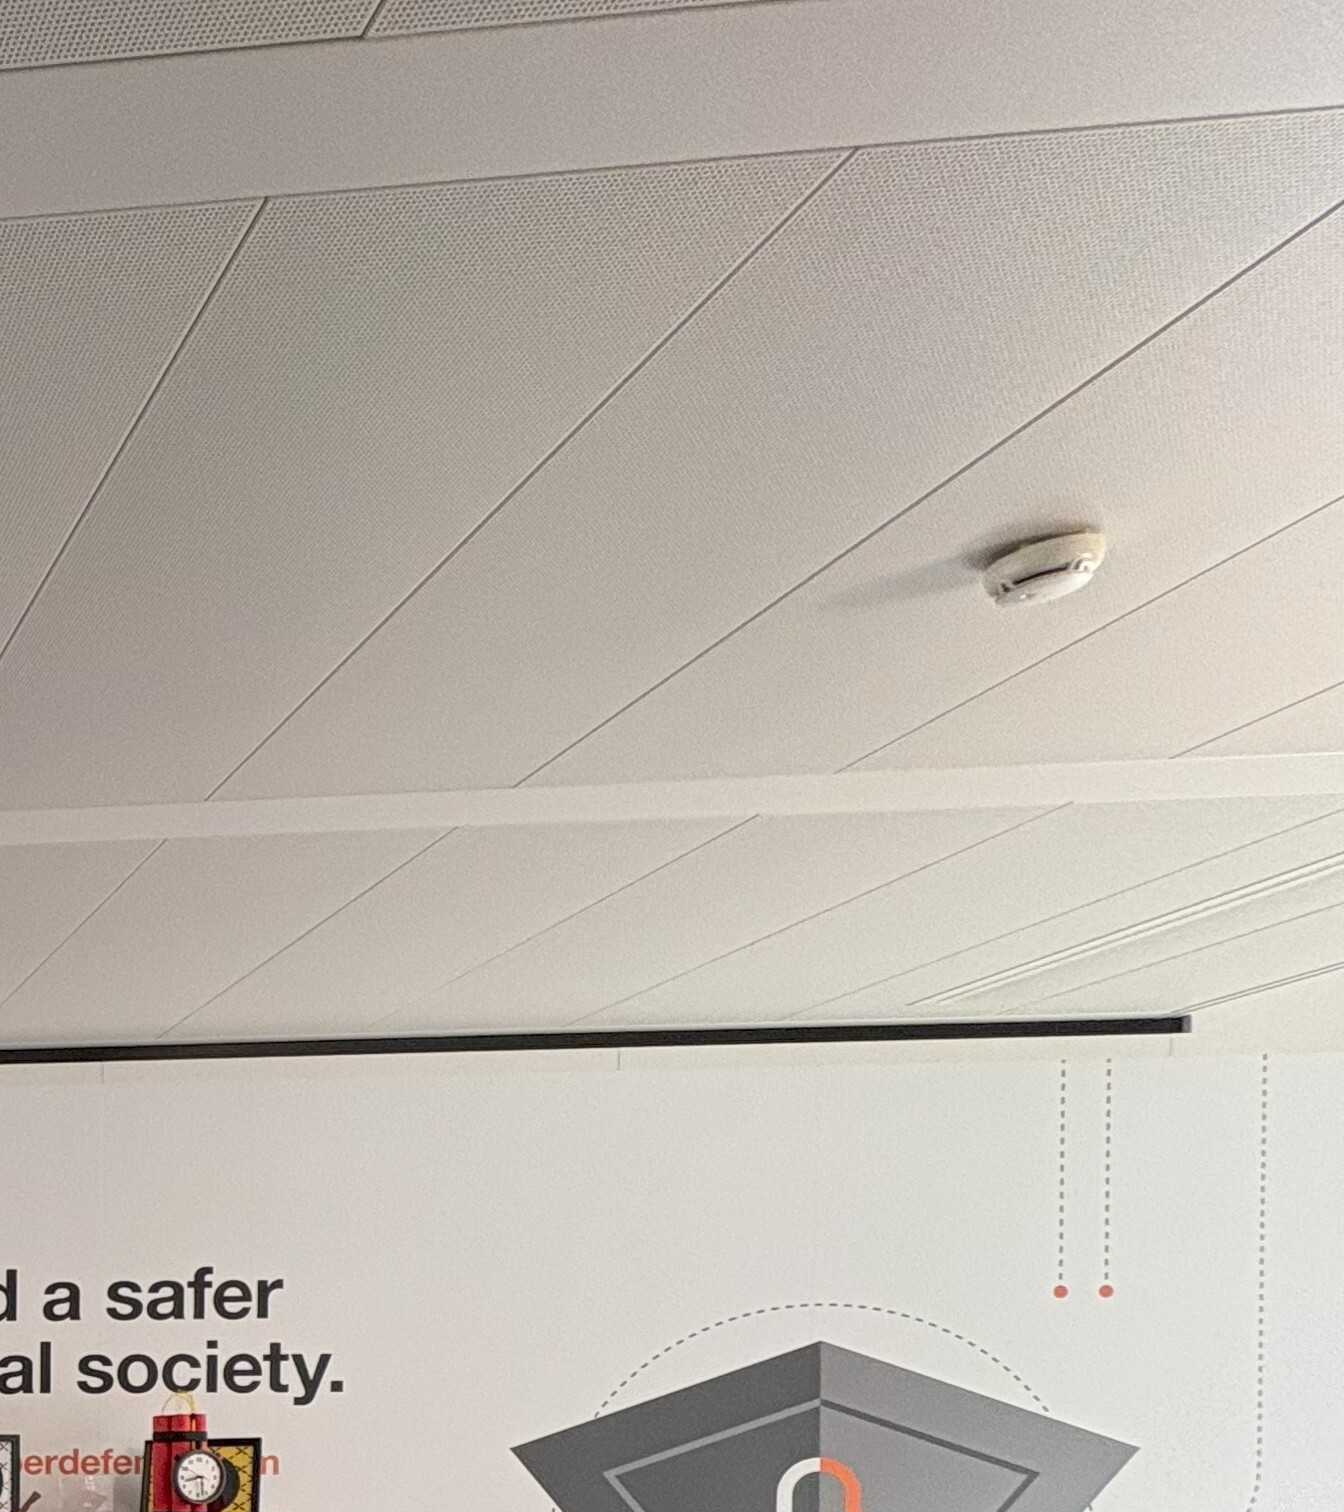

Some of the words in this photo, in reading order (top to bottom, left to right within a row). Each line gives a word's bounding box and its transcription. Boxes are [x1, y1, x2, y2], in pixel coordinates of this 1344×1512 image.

[42, 1281, 81, 1322] a
[106, 1266, 284, 1321] safer
[76, 1339, 344, 1406] society.
